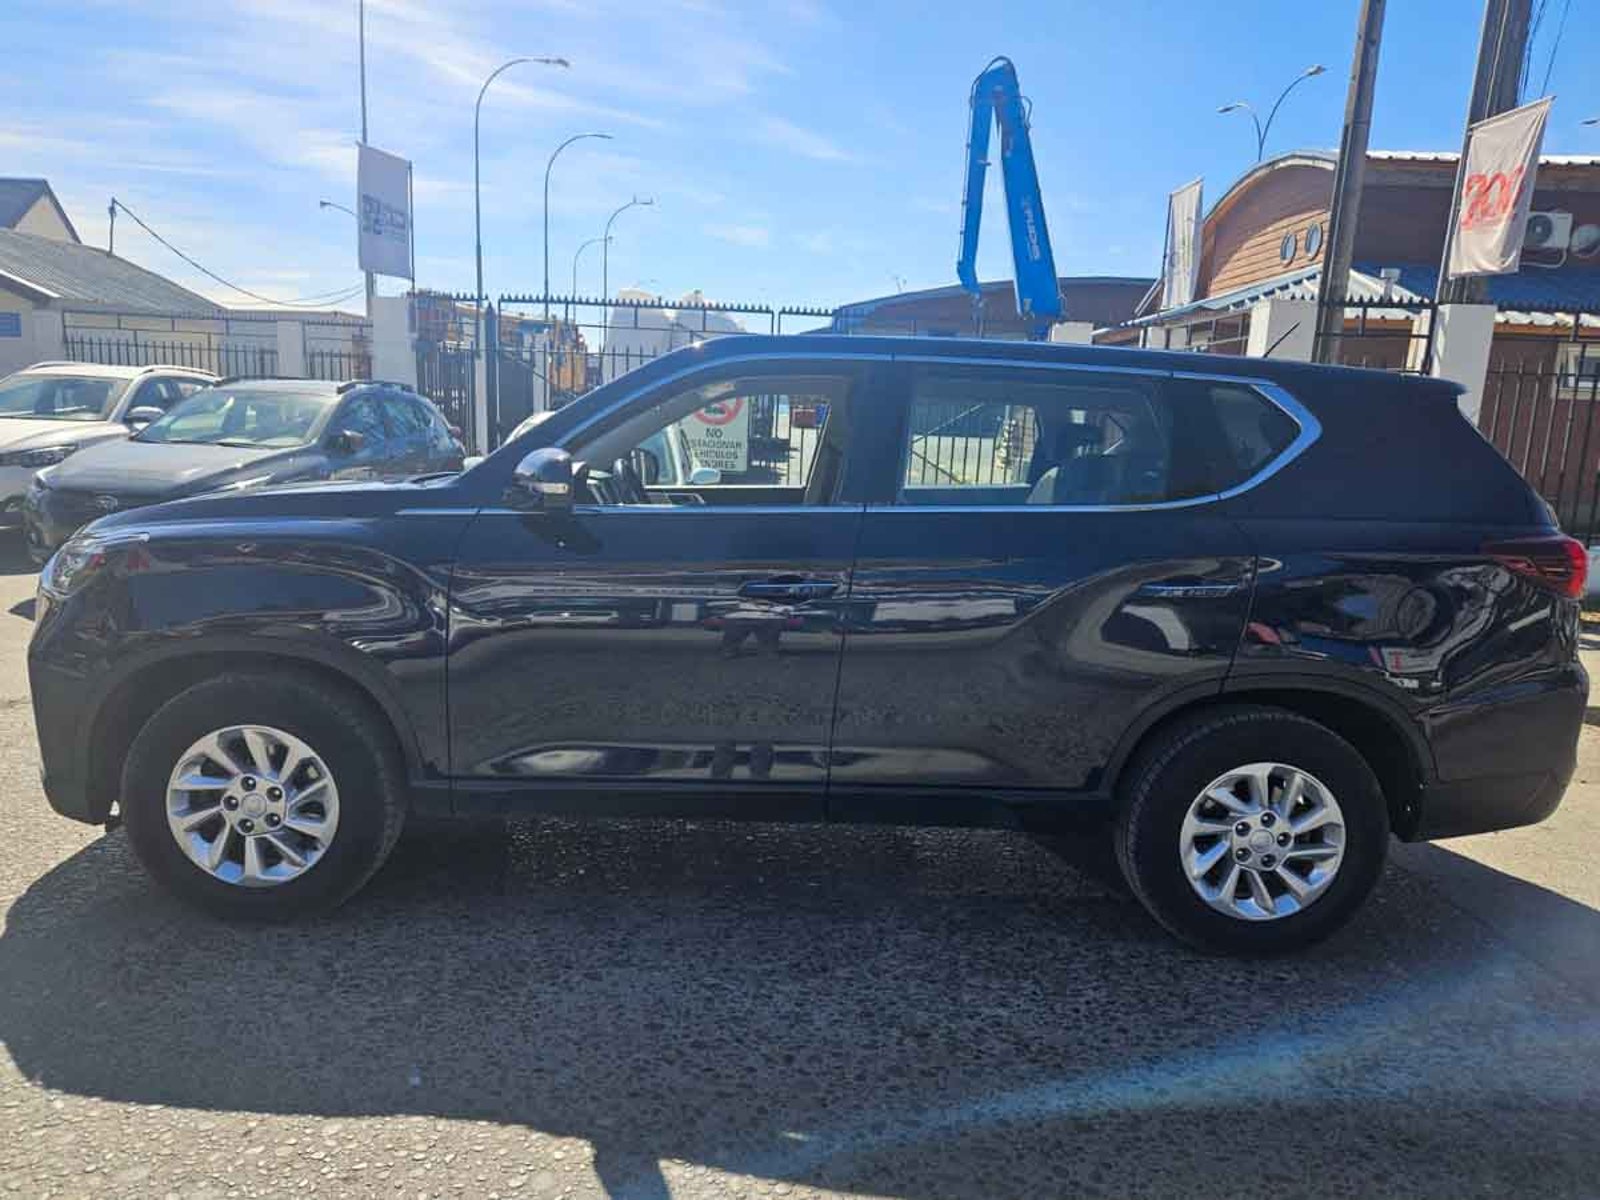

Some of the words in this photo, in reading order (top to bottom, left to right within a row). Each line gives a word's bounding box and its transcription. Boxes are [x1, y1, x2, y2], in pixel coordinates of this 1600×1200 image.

[705, 427, 723, 438] NO
[689, 438, 742, 449] STACIONAR
[692, 448, 739, 459] EHICULOS
[697, 459, 737, 469] ENORES
